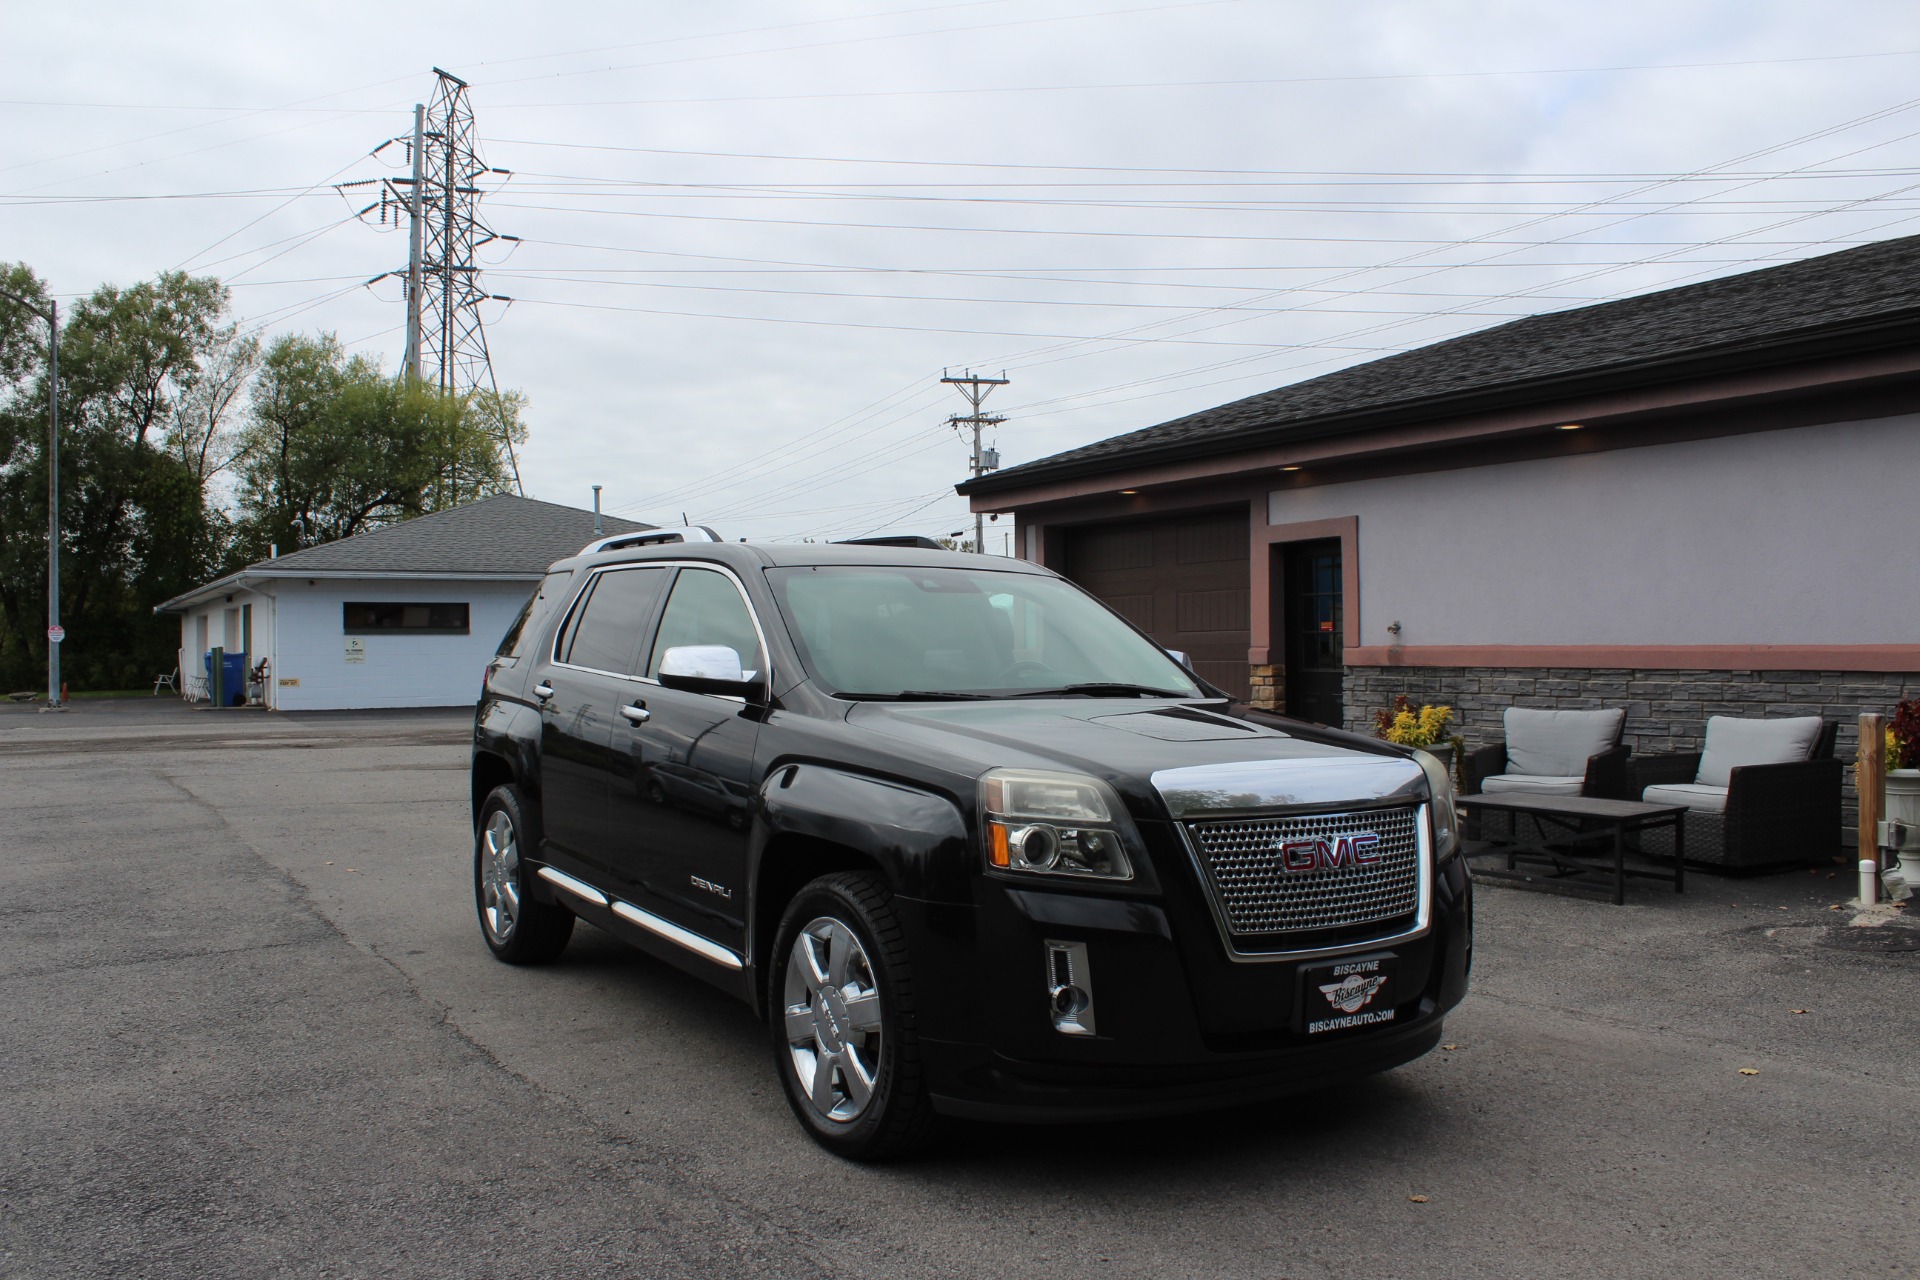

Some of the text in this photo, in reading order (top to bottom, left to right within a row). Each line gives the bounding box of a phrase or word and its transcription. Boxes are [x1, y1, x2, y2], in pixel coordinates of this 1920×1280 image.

[1280, 834, 1381, 872] GMC
[690, 875, 732, 899] DENALI
[1333, 960, 1380, 976] BISCAYNE
[1332, 975, 1380, 1006] Biscayne
[1308, 1009, 1395, 1034] BISCAYNEAUTO.COM
